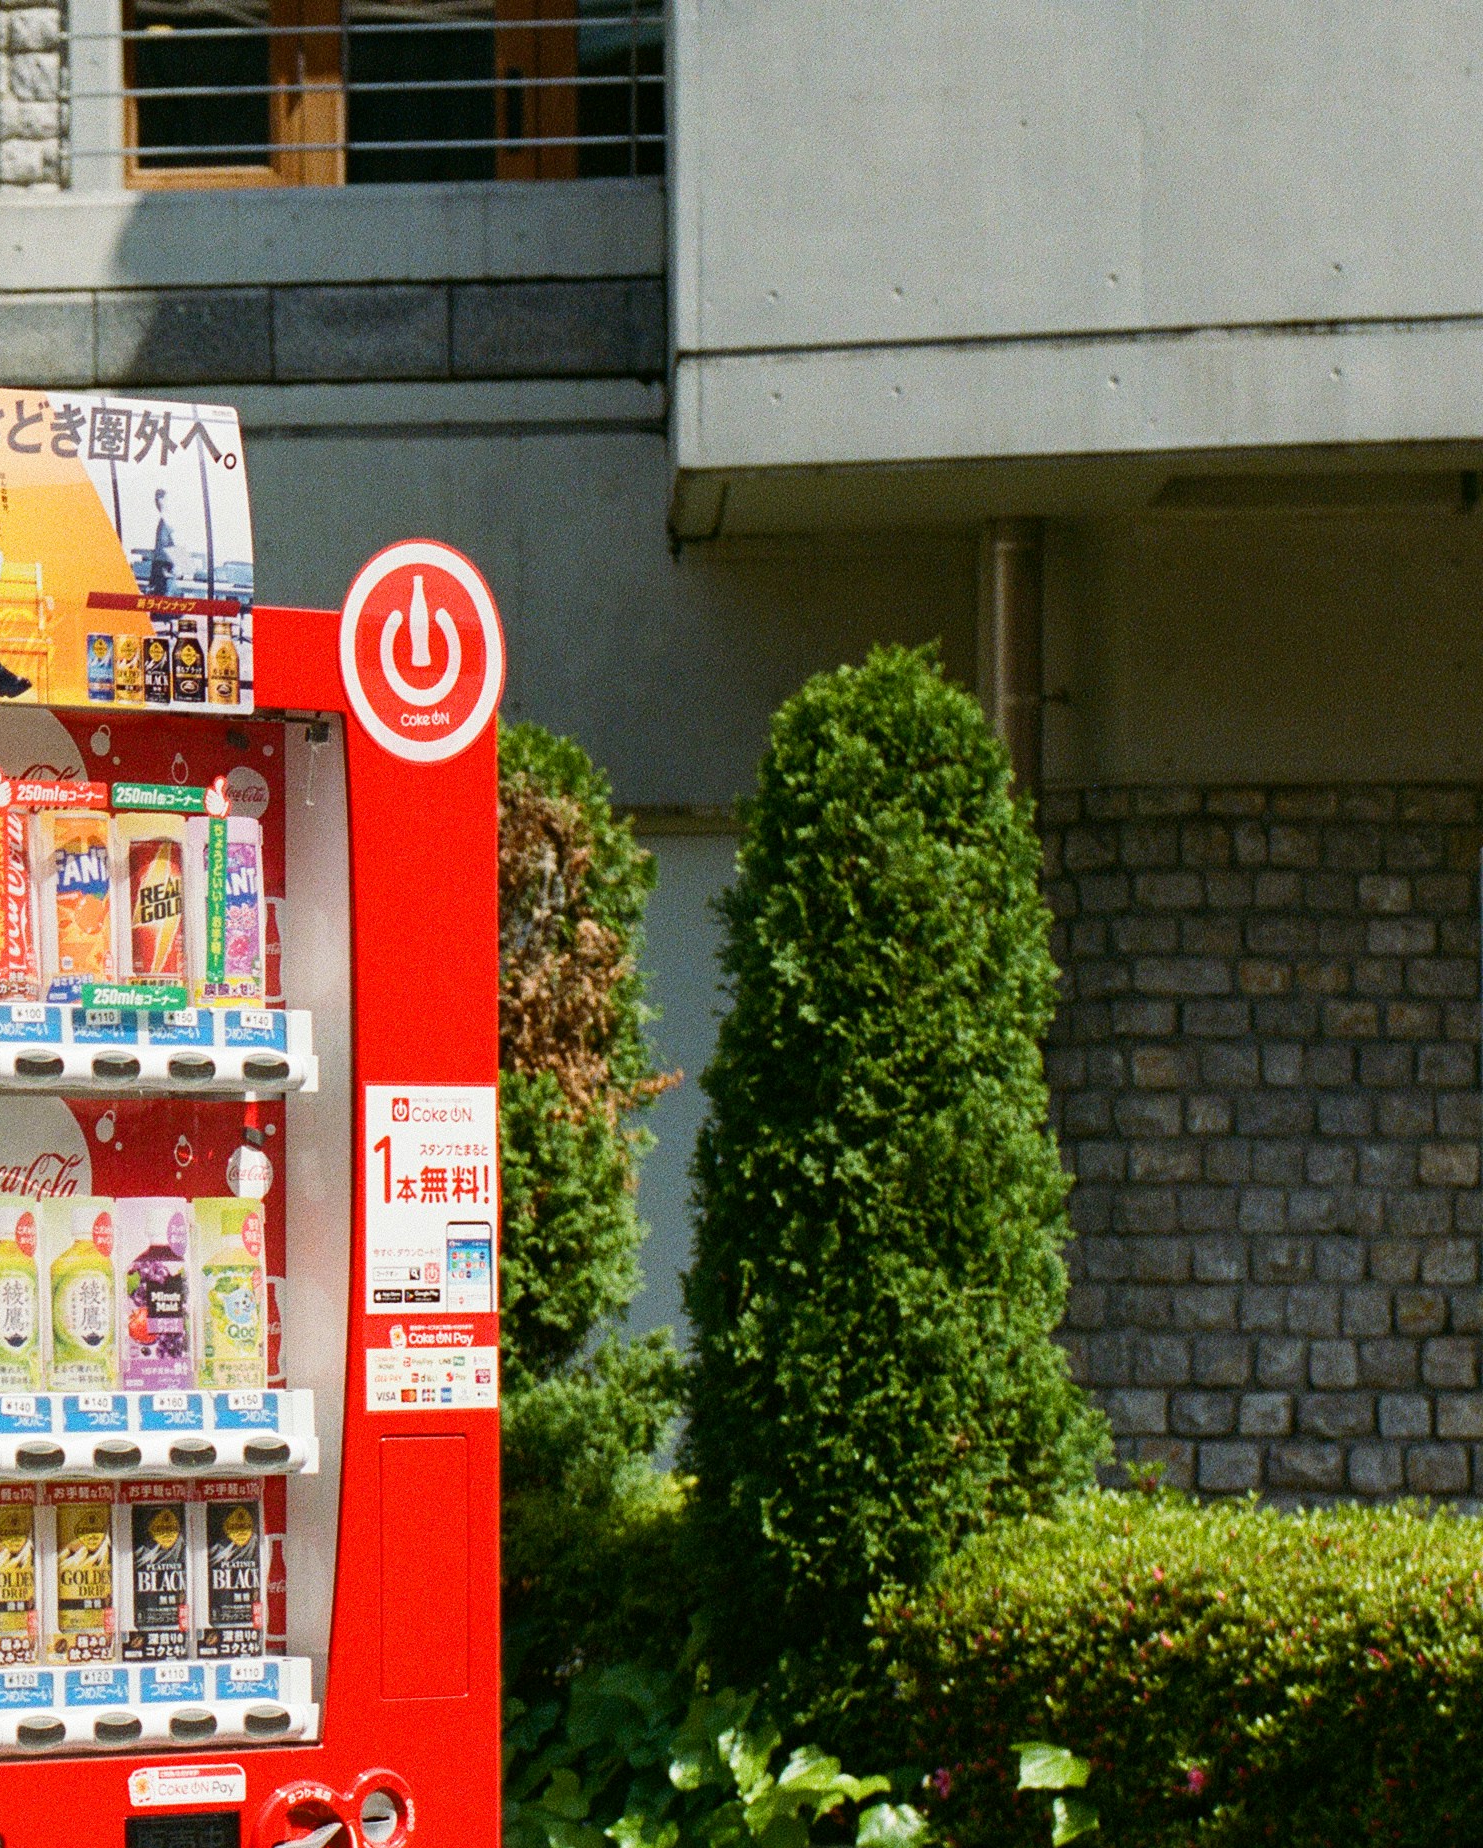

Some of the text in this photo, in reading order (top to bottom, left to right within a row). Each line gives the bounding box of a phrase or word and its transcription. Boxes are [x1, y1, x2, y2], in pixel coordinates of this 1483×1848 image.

[400, 711, 450, 727] Coke ON
[16, 784, 105, 804] 250ml缶コーナー
[116, 787, 203, 806] 250ml缶コーナー
[93, 987, 179, 1006] 250ml缶コーナー
[411, 1104, 474, 1123] Coke ON
[419, 1144, 489, 1157] スタンプたまると
[373, 1135, 490, 1205] 1本無料!
[408, 1331, 435, 1346] Coke
[453, 1331, 475, 1348] Pay
[375, 1390, 397, 1402] VISA
[157, 1780, 190, 1797] Coke
[211, 1779, 237, 1797] Pay
